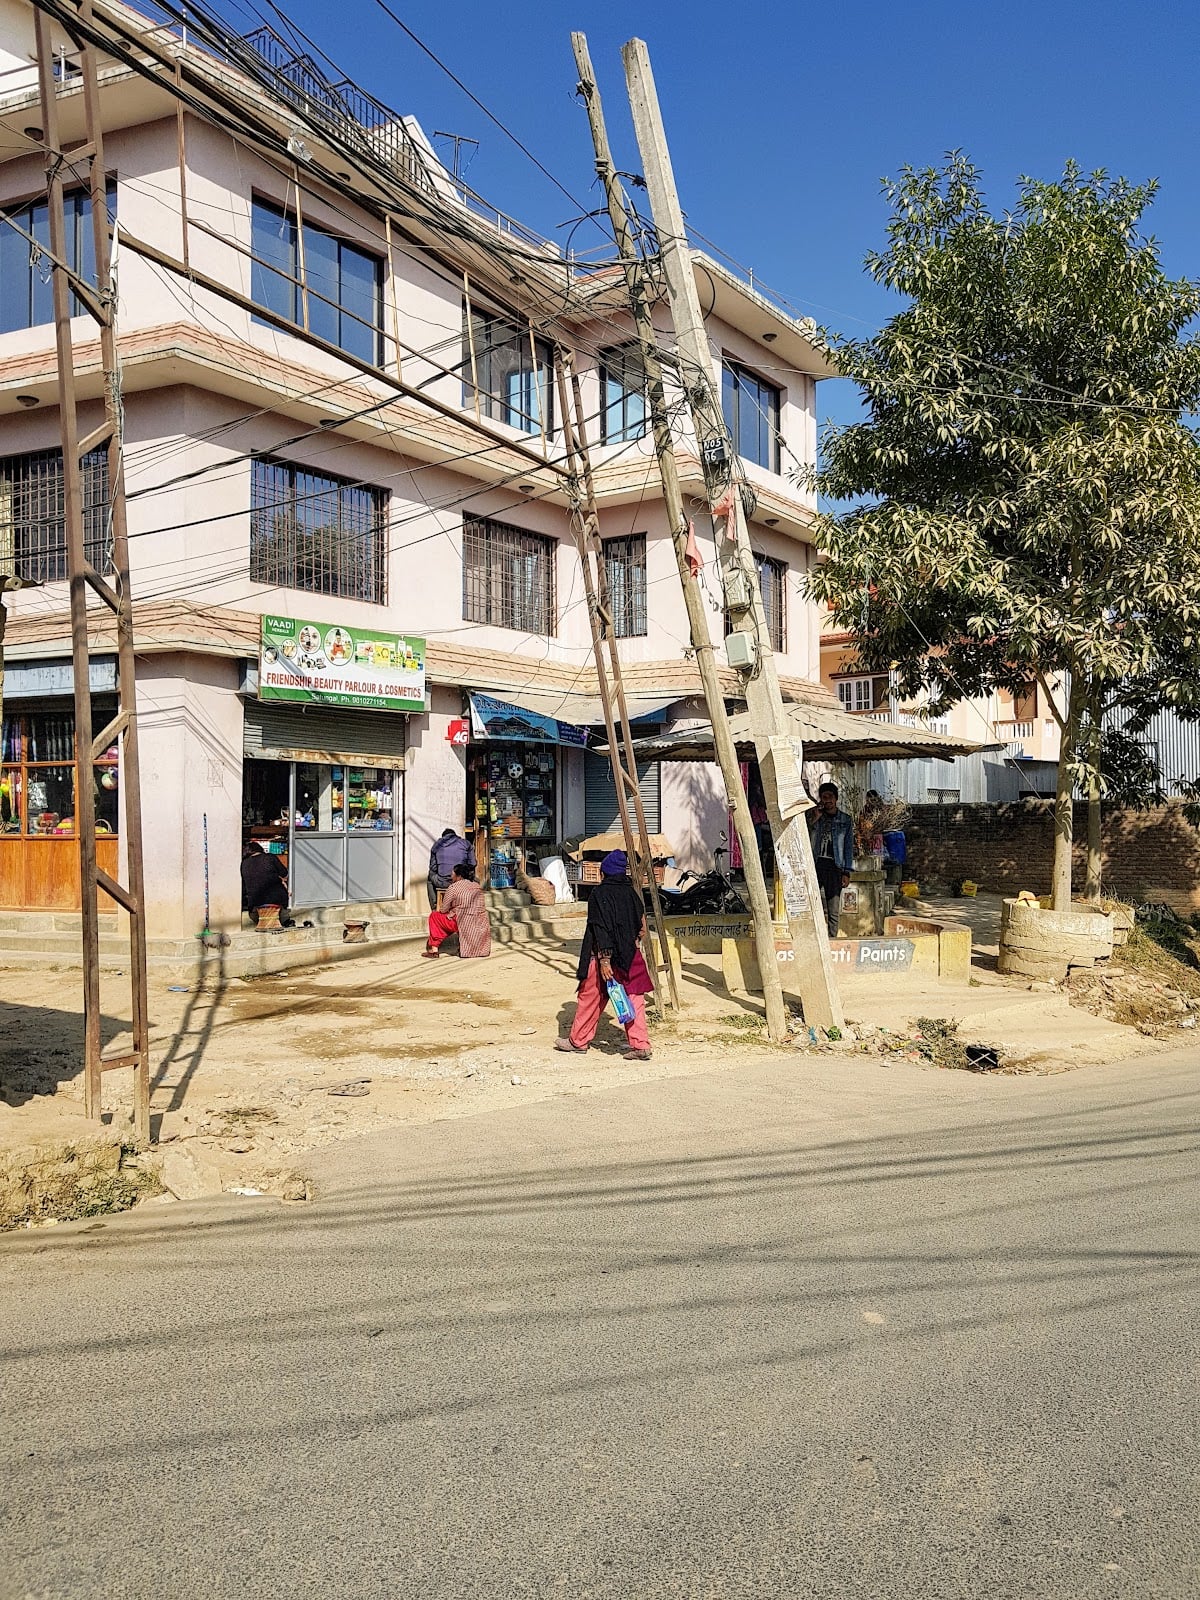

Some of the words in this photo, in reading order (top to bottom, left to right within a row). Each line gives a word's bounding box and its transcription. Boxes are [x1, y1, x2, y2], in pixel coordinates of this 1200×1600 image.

[704, 451, 717, 461] 06
[267, 618, 295, 630] VAADI
[266, 672, 312, 688] FRIENDSHIP
[313, 677, 344, 691] BEAUTY
[344, 680, 377, 694] PARLOUR
[377, 683, 383, 695] &
[384, 684, 422, 699] COSMETICS
[452, 730, 469, 743] 4G
[860, 946, 906, 963] Paints
